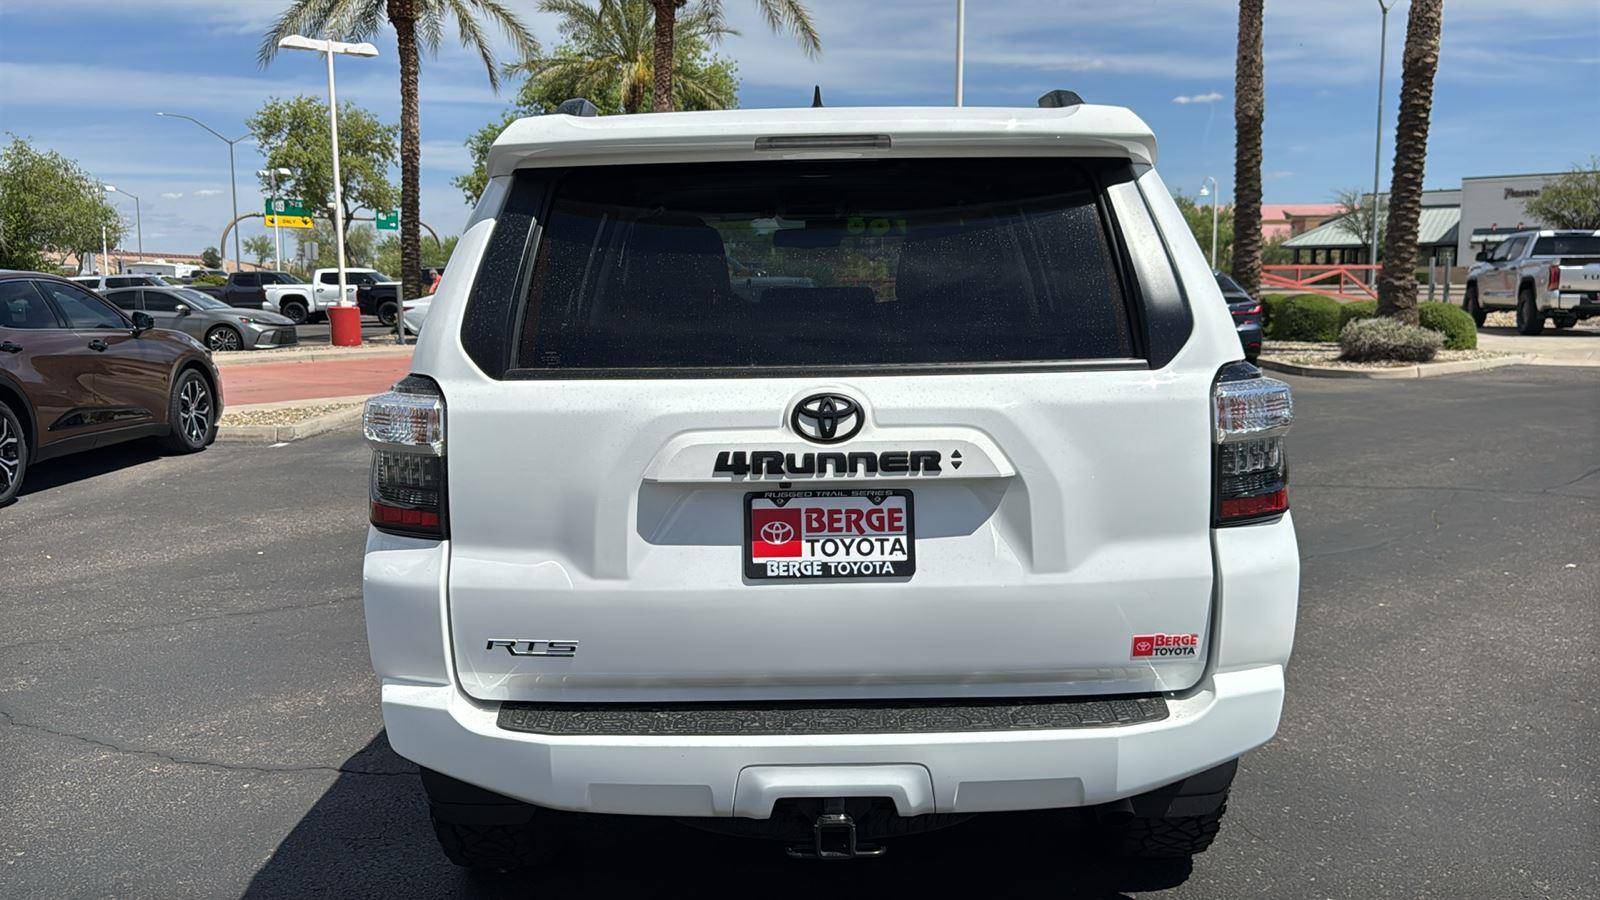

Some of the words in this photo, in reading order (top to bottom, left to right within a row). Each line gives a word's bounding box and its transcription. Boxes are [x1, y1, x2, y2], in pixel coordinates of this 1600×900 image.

[804, 507, 904, 535] BERGE
[805, 538, 907, 557] TOYOTA
[766, 561, 823, 577] BERGE
[828, 561, 895, 575] TOYOTA
[486, 638, 579, 657] RTS
[1154, 633, 1198, 647] BERGE
[1153, 648, 1195, 656] TOYOTA
